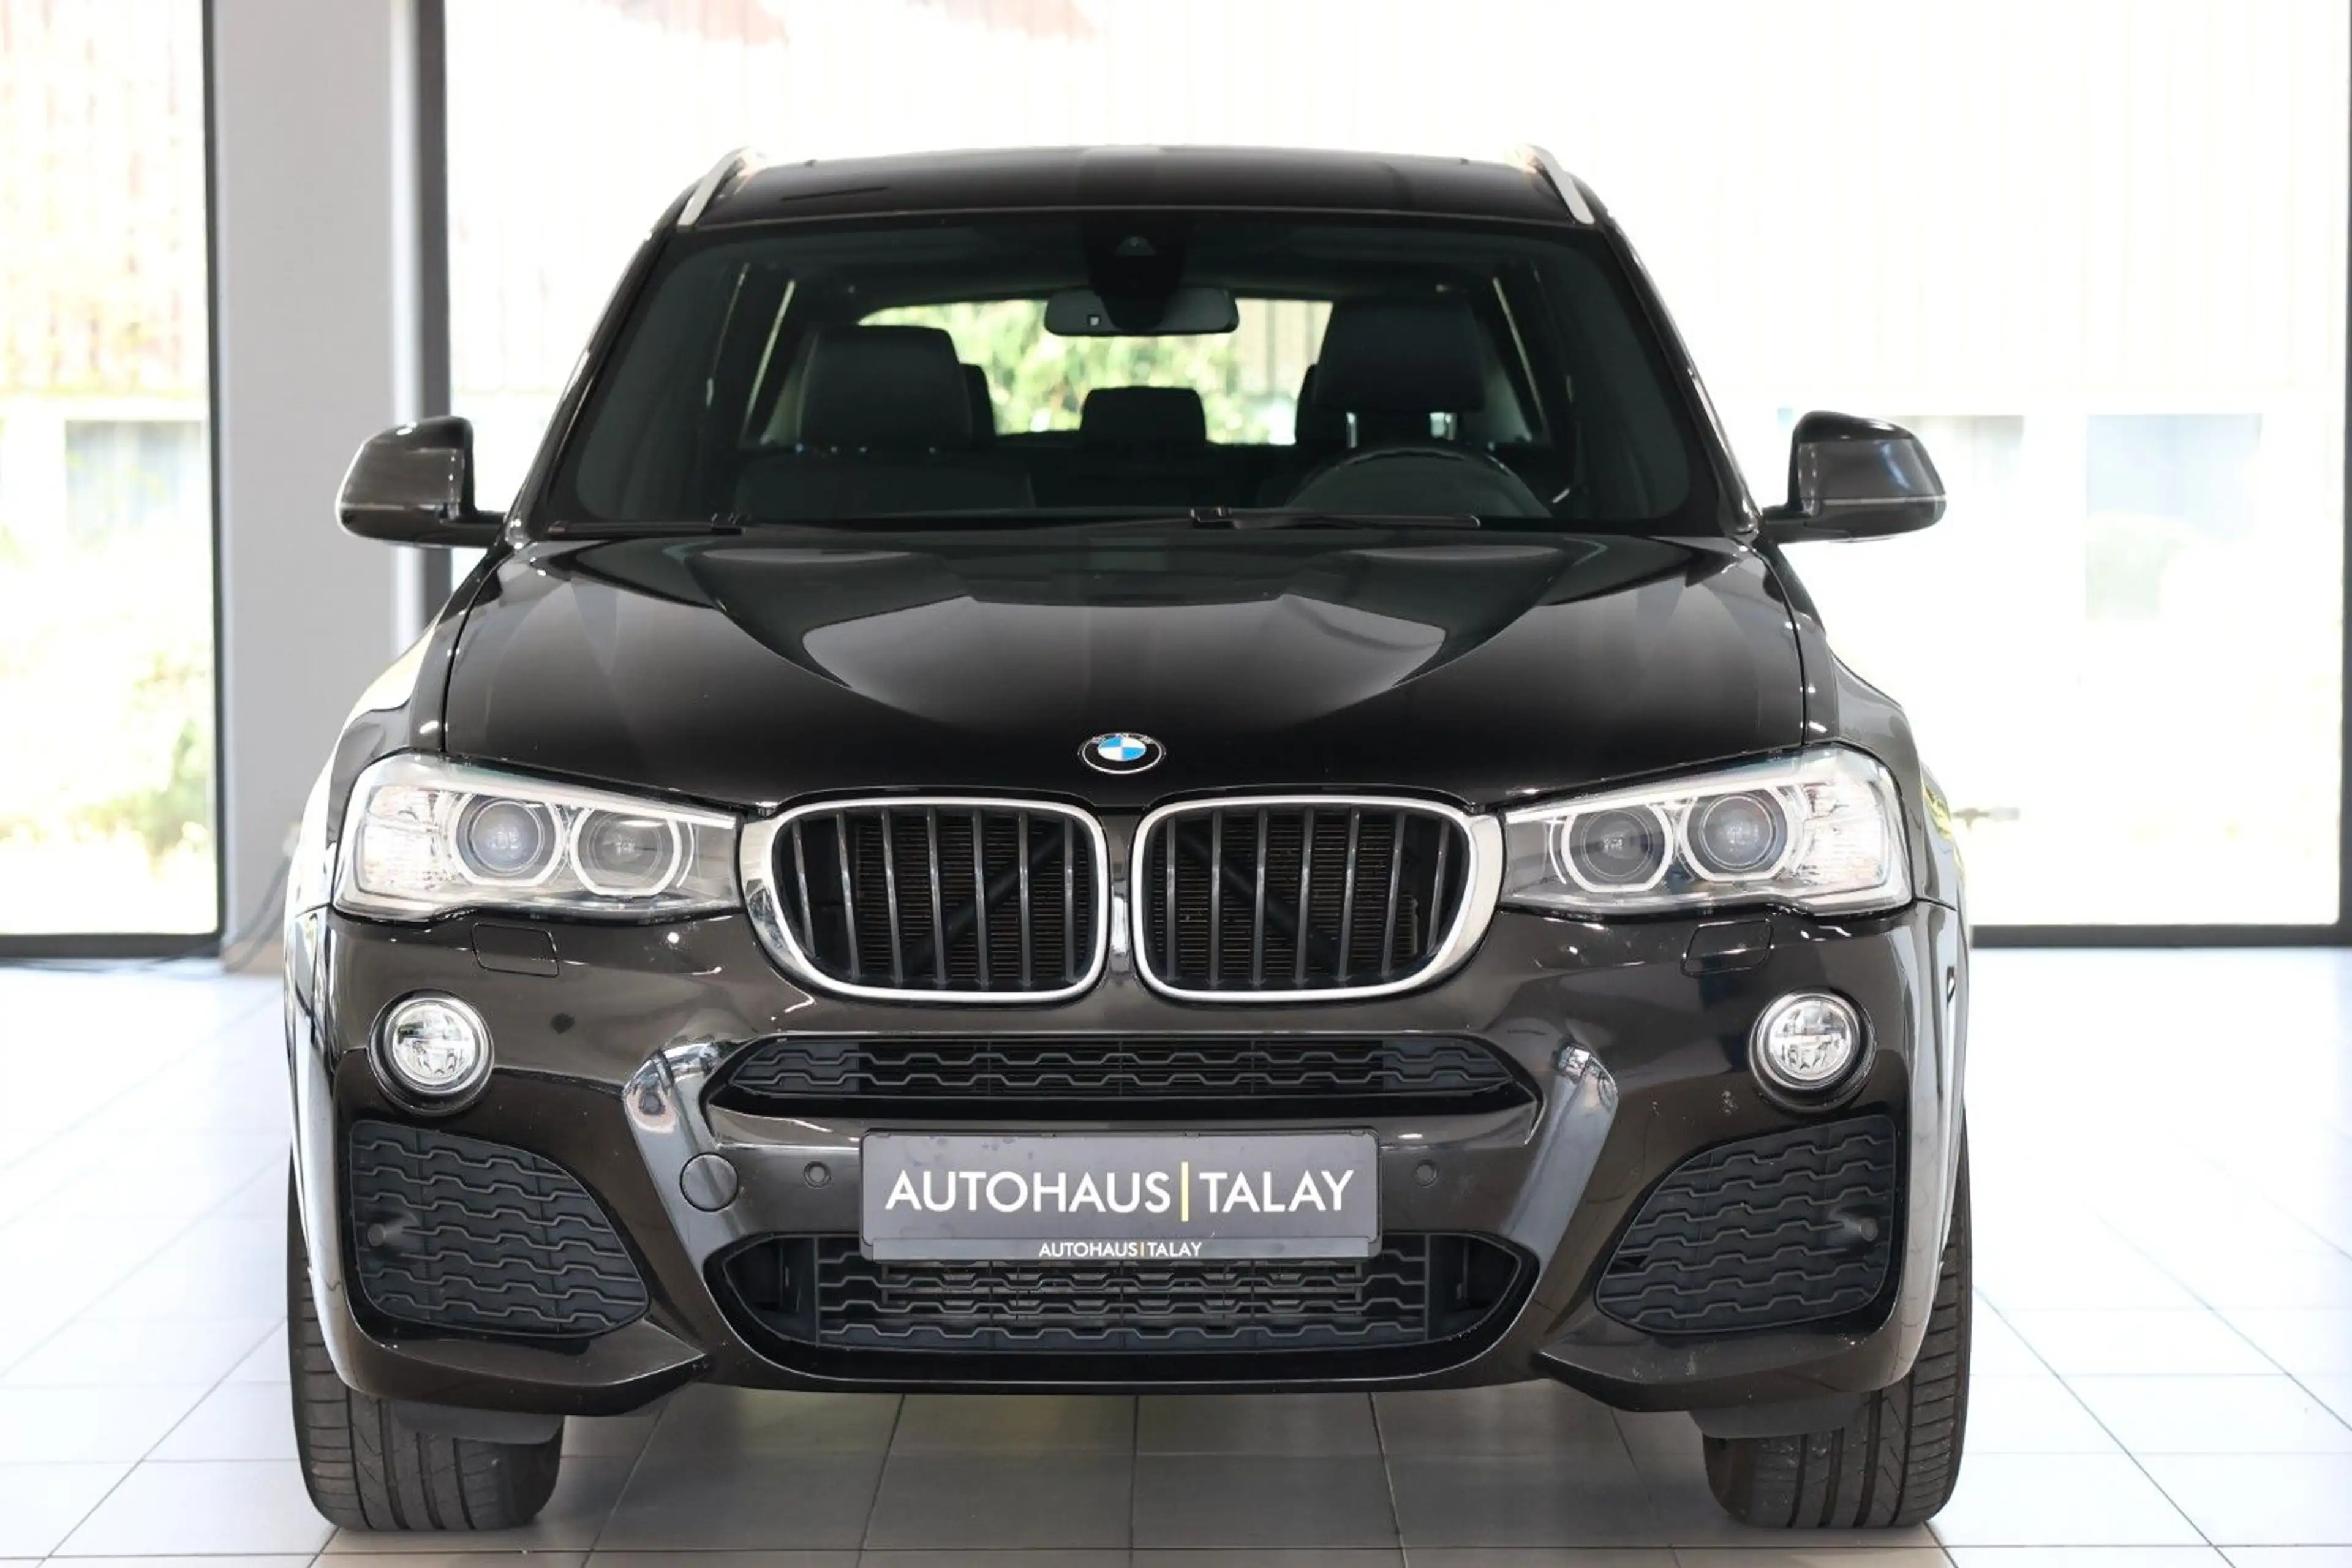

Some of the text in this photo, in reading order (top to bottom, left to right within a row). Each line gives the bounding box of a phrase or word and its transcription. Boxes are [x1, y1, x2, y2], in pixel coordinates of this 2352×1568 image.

[884, 1169, 1355, 1213] AUTOHAUS TALAY
[1038, 1240, 1203, 1259] AUTOHAUS TALAY
